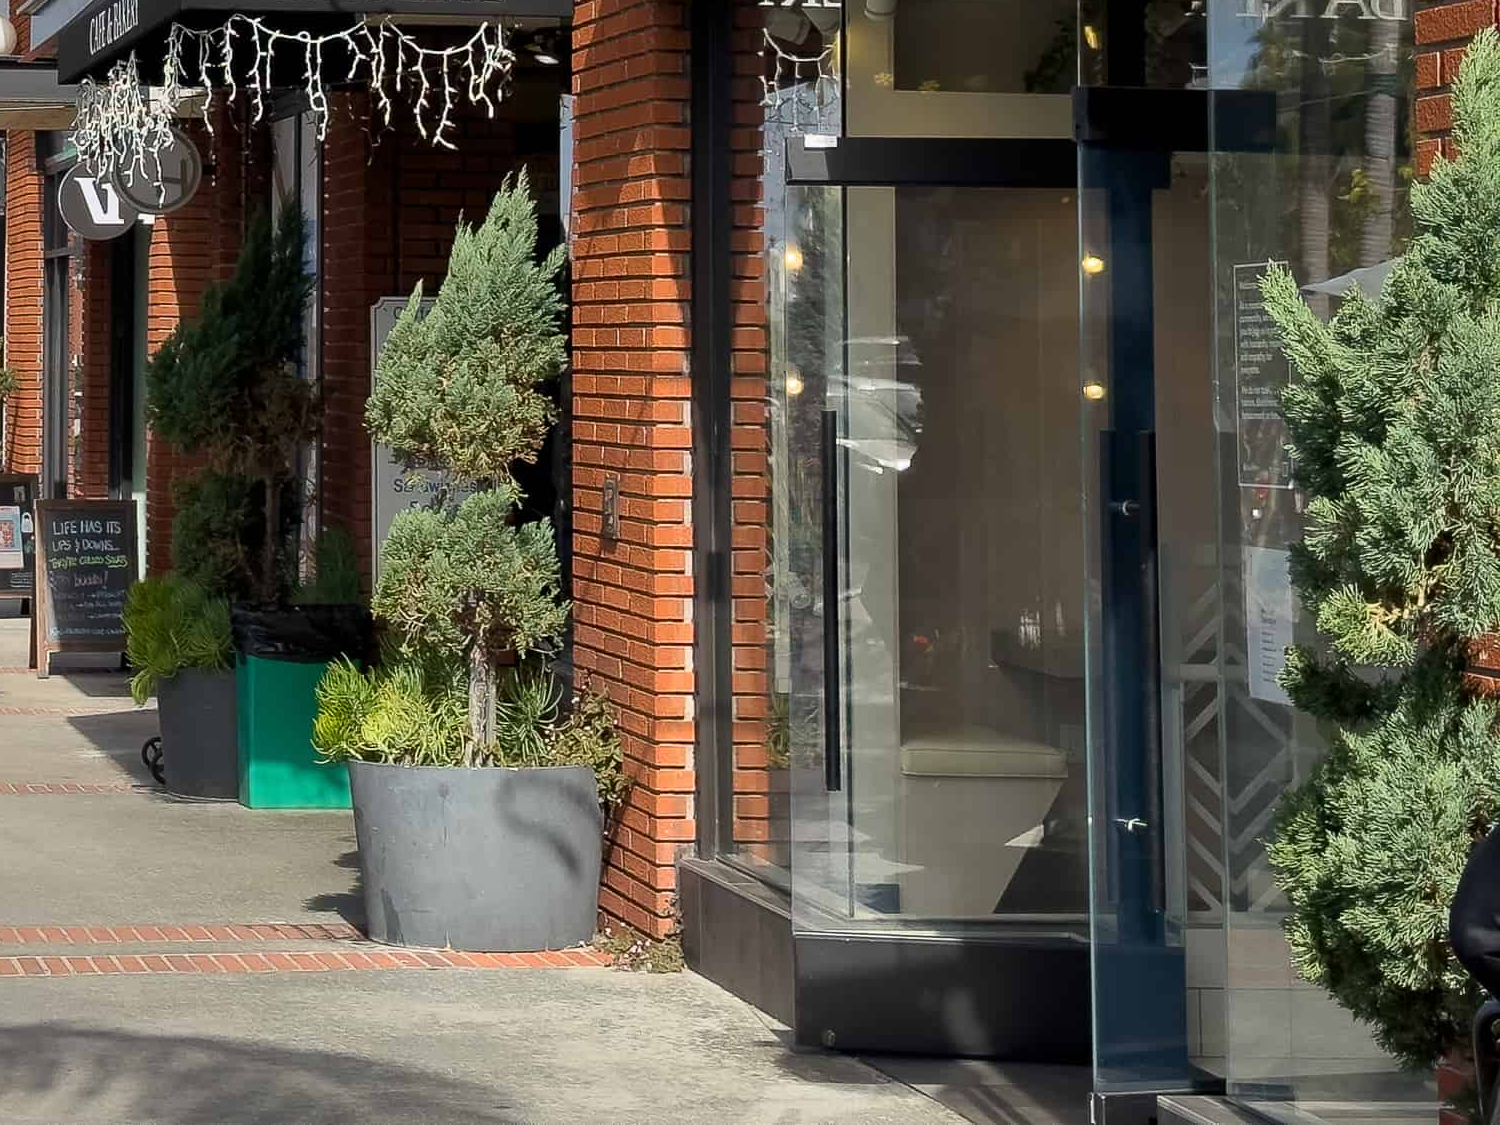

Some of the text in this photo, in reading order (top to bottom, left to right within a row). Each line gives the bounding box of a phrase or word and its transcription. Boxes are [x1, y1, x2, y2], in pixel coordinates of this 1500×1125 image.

[89, 10, 106, 55] CAFE
[52, 520, 122, 535] LIFE HAS ITS
